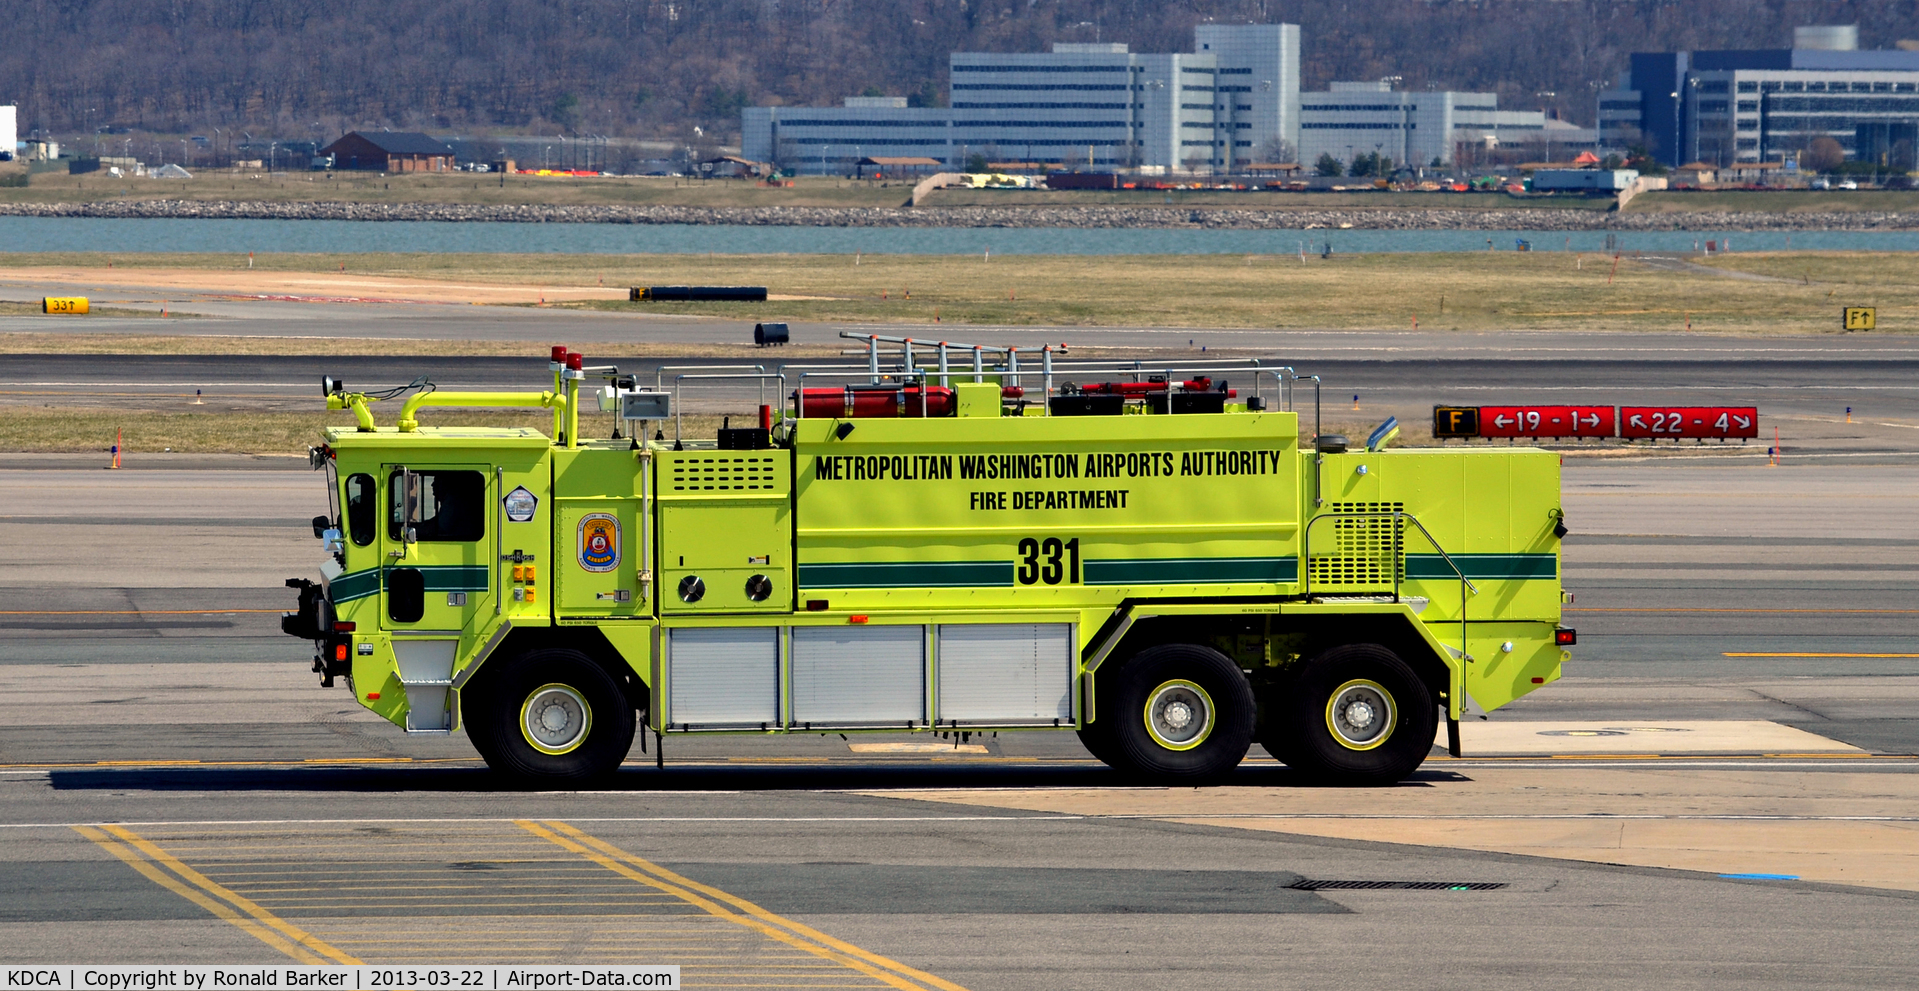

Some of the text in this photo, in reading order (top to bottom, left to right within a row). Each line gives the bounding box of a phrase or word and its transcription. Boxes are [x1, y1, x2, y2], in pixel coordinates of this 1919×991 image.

[639, 288, 646, 299] F
[53, 300, 68, 311] 33
[1852, 311, 1859, 325] F
[1450, 411, 1463, 431] F
[1516, 411, 1540, 431] 19
[1651, 412, 1683, 433] 22
[1714, 412, 1730, 432] 4
[815, 449, 1281, 481] METROPOLITAN WASHINGTON AIRPORTS AUTHORITY
[970, 490, 1130, 511] FIRE DEPARTMENT
[1017, 536, 1080, 585] 331
